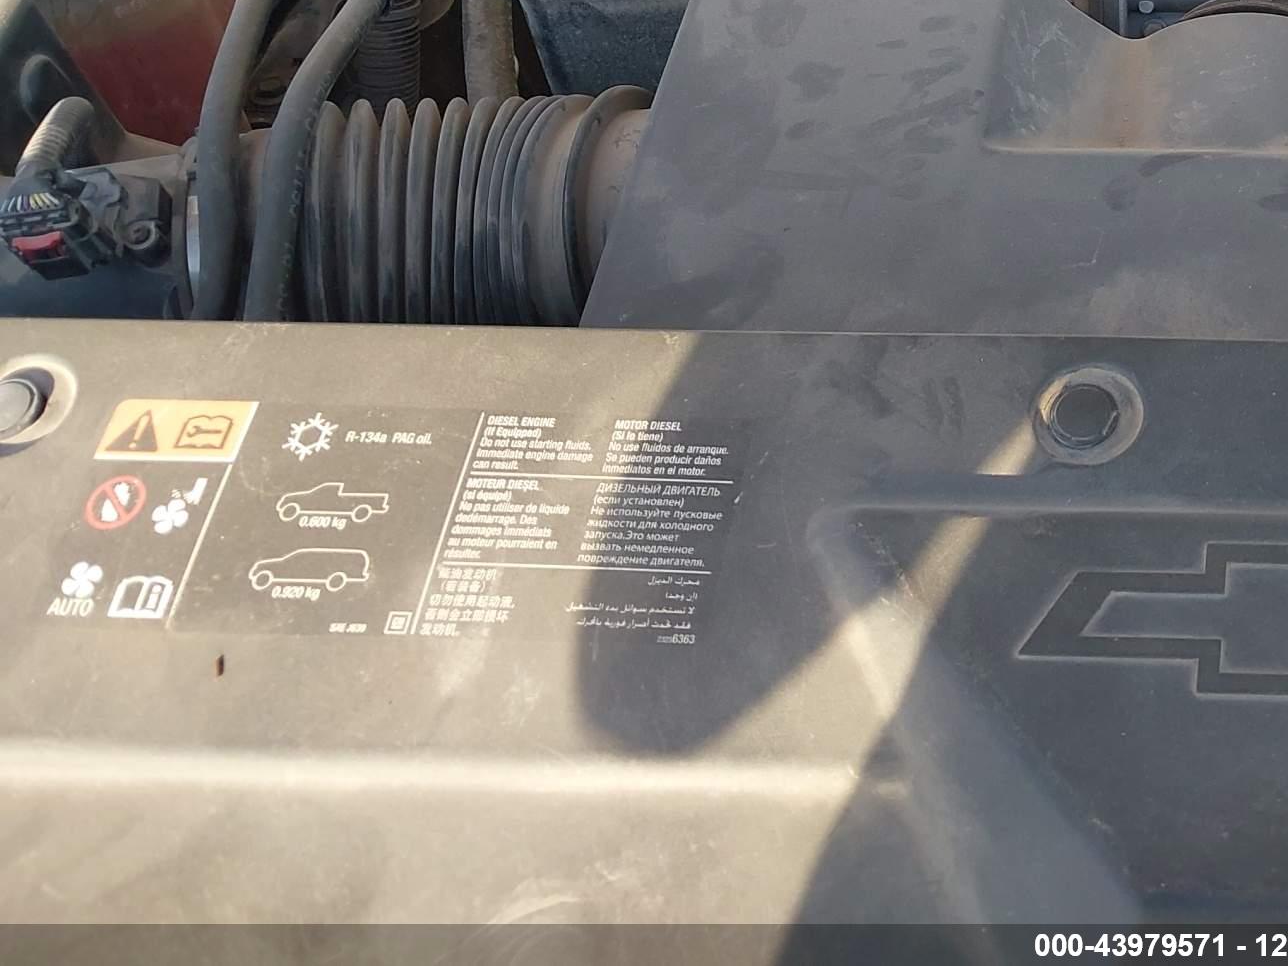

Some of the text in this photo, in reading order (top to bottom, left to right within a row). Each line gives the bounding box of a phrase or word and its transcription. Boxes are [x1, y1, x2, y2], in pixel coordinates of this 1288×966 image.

[487, 416, 556, 428] DIESEL ENGINE
[615, 420, 681, 431] MOTOR DIESEL
[345, 430, 387, 443] R-134a
[392, 432, 416, 444] PAG
[496, 427, 542, 438] Equipped)
[612, 431, 663, 442] (Si lo tiene)
[480, 437, 592, 451] Do not use starting fluids.
[609, 442, 620, 451] No
[642, 442, 671, 452] fluidos
[673, 444, 685, 453] de
[687, 446, 728, 455] arranque.
[476, 448, 594, 463] Immediate engine damage
[606, 453, 721, 465] Se pueden producir daños
[491, 461, 518, 470] result.
[654, 467, 665, 475] en
[667, 466, 676, 475] el
[678, 467, 706, 476] motor.
[466, 478, 506, 489] MOTEUR
[596, 482, 720, 496] ДИЗЕЛЬНЫЙ ДВИГАТЕЛЬ
[594, 495, 685, 508] (если установлен)
[459, 502, 570, 515] Ne pas utiliser de liquide
[590, 506, 723, 520] Не используйте пусковые
[331, 516, 347, 530] kg
[520, 514, 538, 524] Des
[451, 525, 552, 537] dommages immédiats
[587, 519, 714, 532] жидкости для холодного
[646, 533, 679, 542] может
[448, 538, 558, 550] au moteur pourraient en
[580, 542, 694, 554] вызвать немедленное
[577, 554, 705, 567] повреждение двигателя.
[305, 586, 321, 601] kg
[46, 597, 95, 617] AUTO
